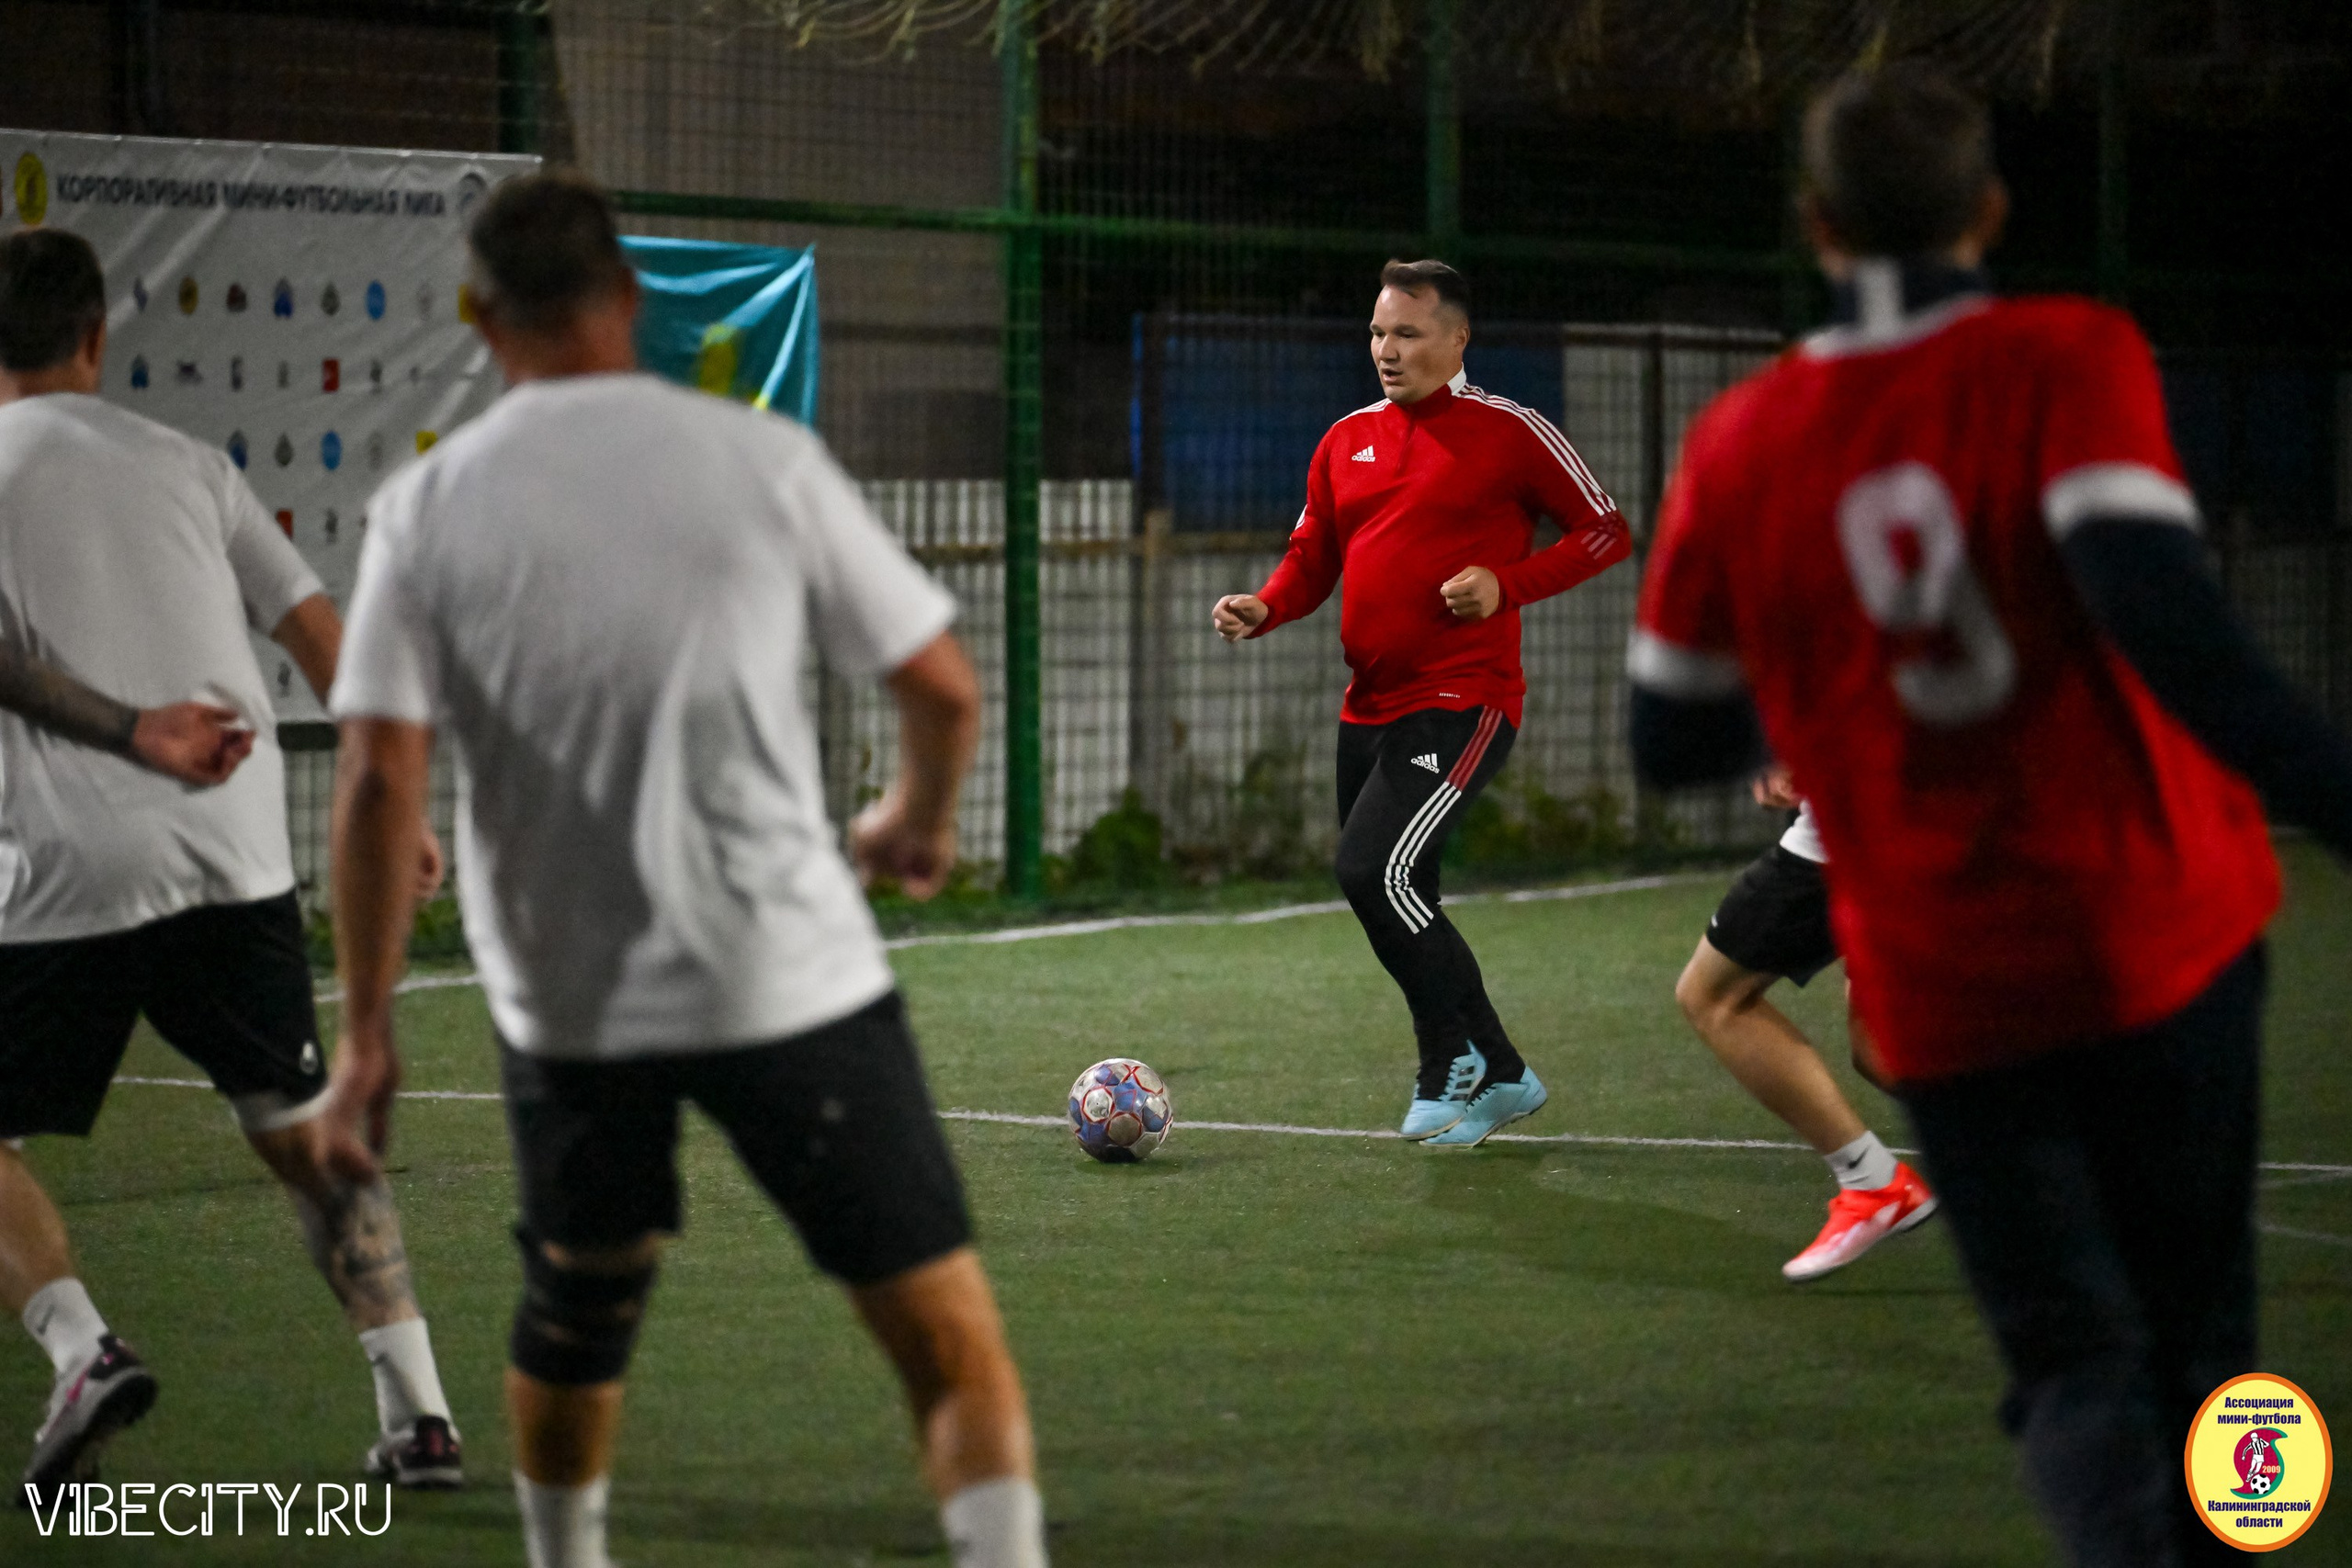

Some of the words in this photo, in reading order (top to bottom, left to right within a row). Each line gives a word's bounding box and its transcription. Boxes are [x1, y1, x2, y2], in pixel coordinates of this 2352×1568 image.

[1351, 454, 1375, 462] adidas
[1836, 461, 2018, 724] 9
[1410, 757, 1440, 773] adidas
